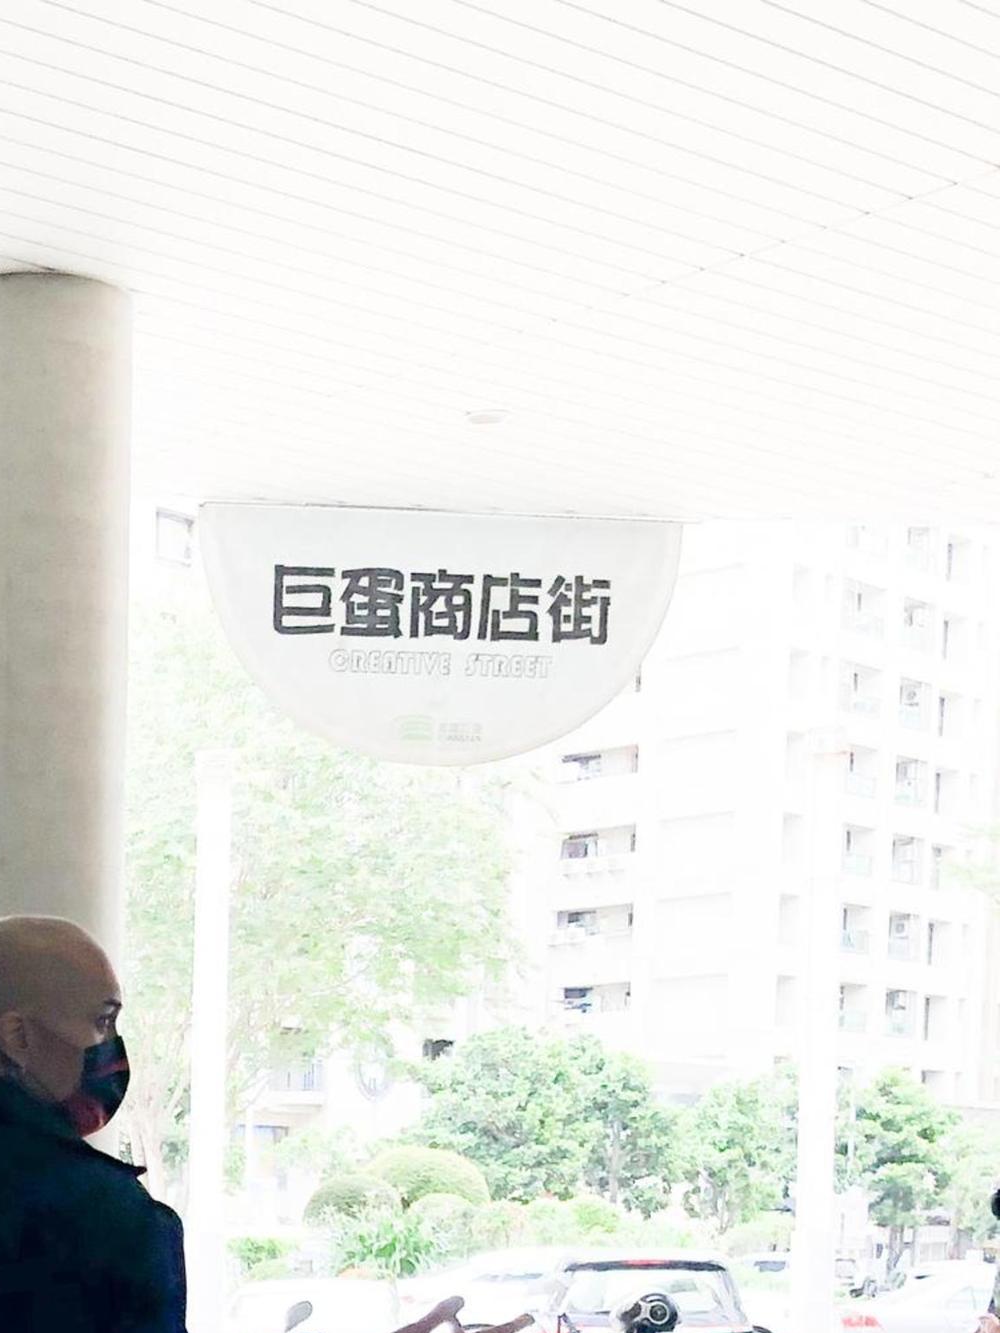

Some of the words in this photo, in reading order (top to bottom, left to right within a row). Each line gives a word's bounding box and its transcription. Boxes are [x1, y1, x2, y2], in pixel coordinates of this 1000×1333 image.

[273, 565, 611, 645] 巨蛋商店街
[328, 648, 451, 676] CREATIVE
[465, 653, 554, 678] STREET
